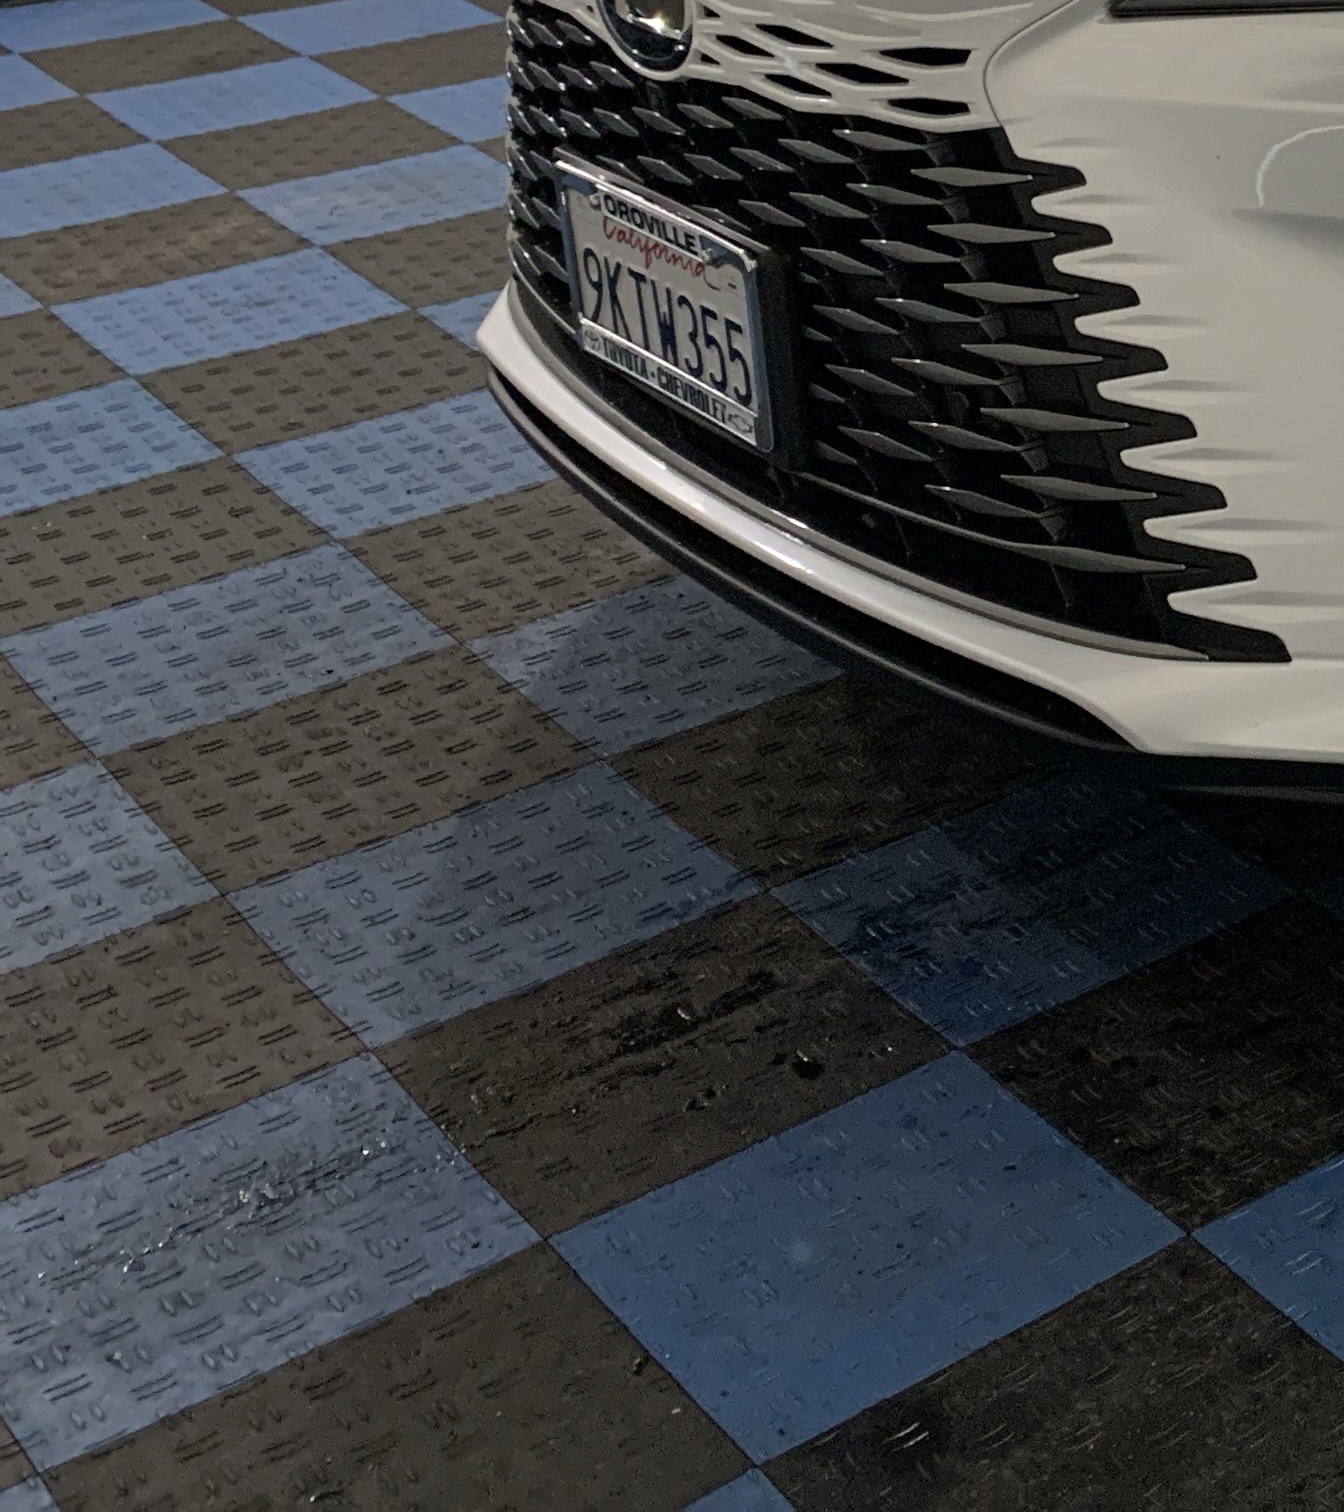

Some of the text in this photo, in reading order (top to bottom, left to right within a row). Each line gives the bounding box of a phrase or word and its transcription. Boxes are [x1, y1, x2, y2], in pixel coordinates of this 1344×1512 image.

[602, 193, 700, 256] OROVILLE
[602, 215, 720, 291] California
[583, 246, 753, 406] 9KTW355
